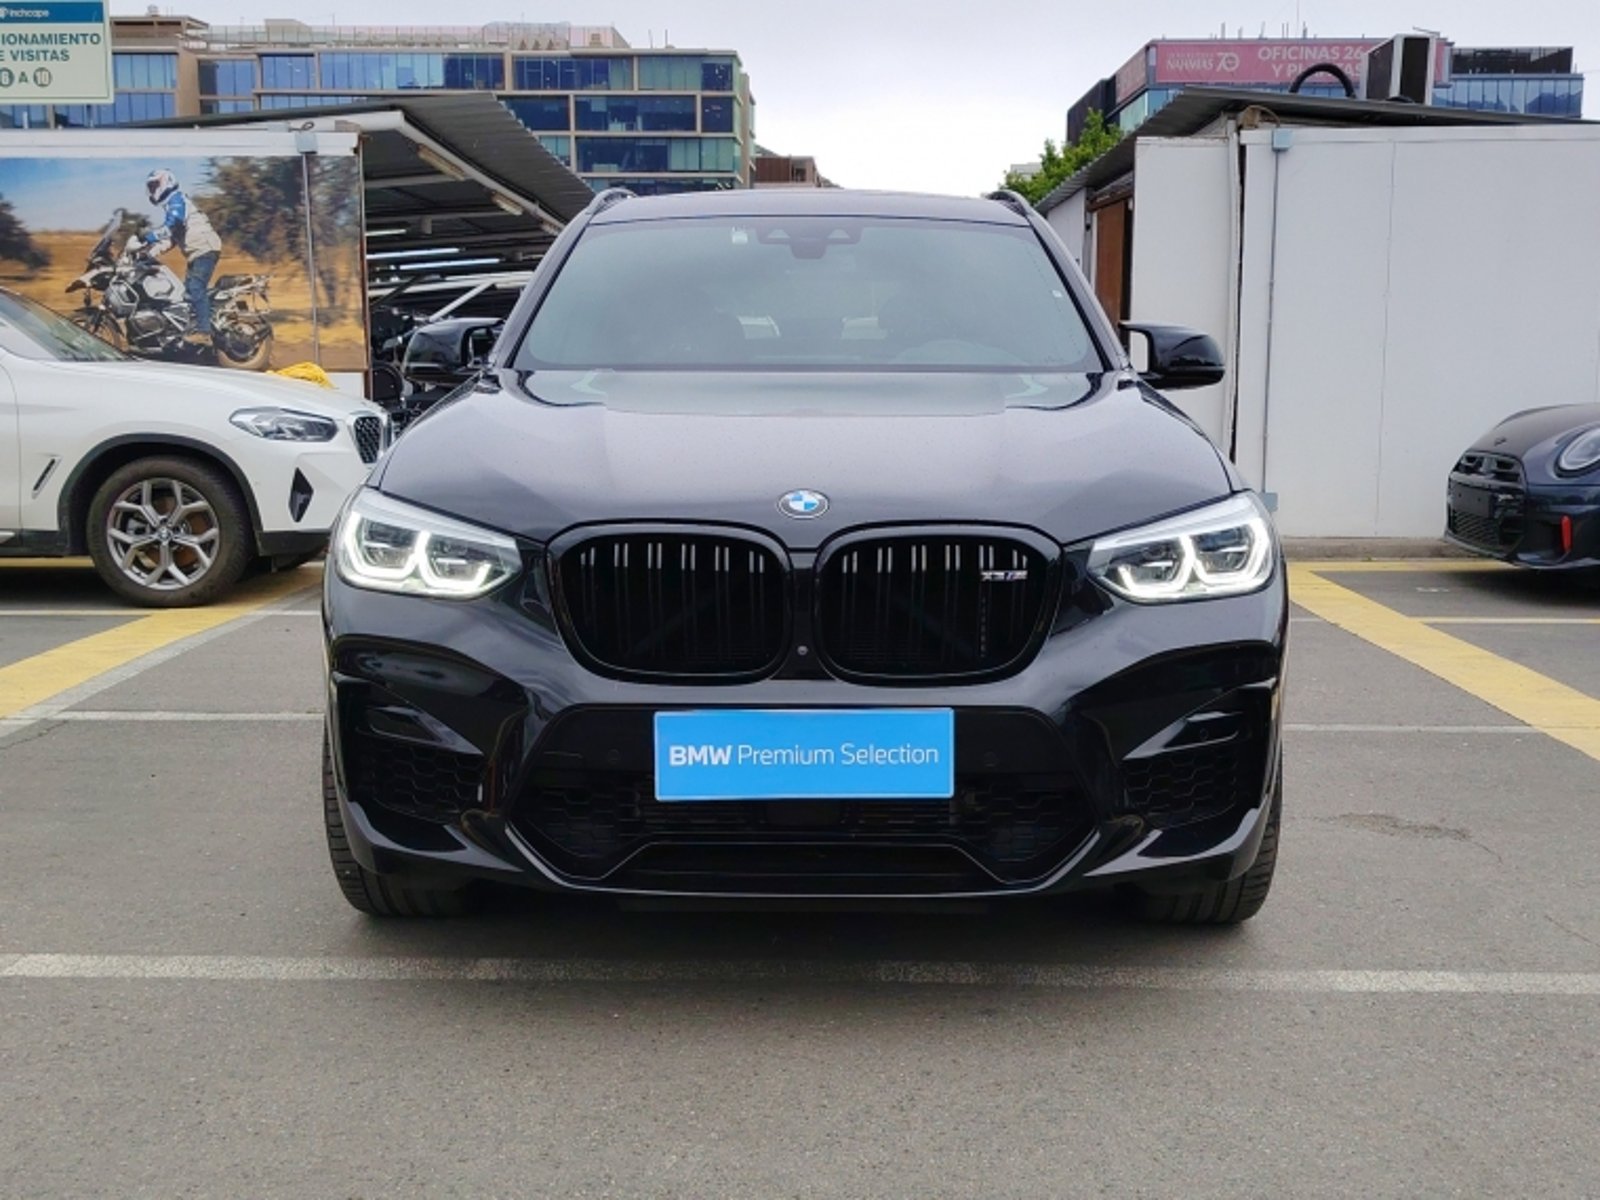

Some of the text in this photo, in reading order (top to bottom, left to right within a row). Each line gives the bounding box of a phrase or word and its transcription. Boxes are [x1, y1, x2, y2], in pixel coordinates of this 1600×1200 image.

[1, 33, 101, 45] IONAMIENTO
[10, 49, 70, 61] VISITAS
[1258, 45, 1341, 61] OFICINAS
[19, 71, 28, 83] A
[1271, 63, 1283, 78] Y
[669, 742, 939, 766] BMW Premium Selection
